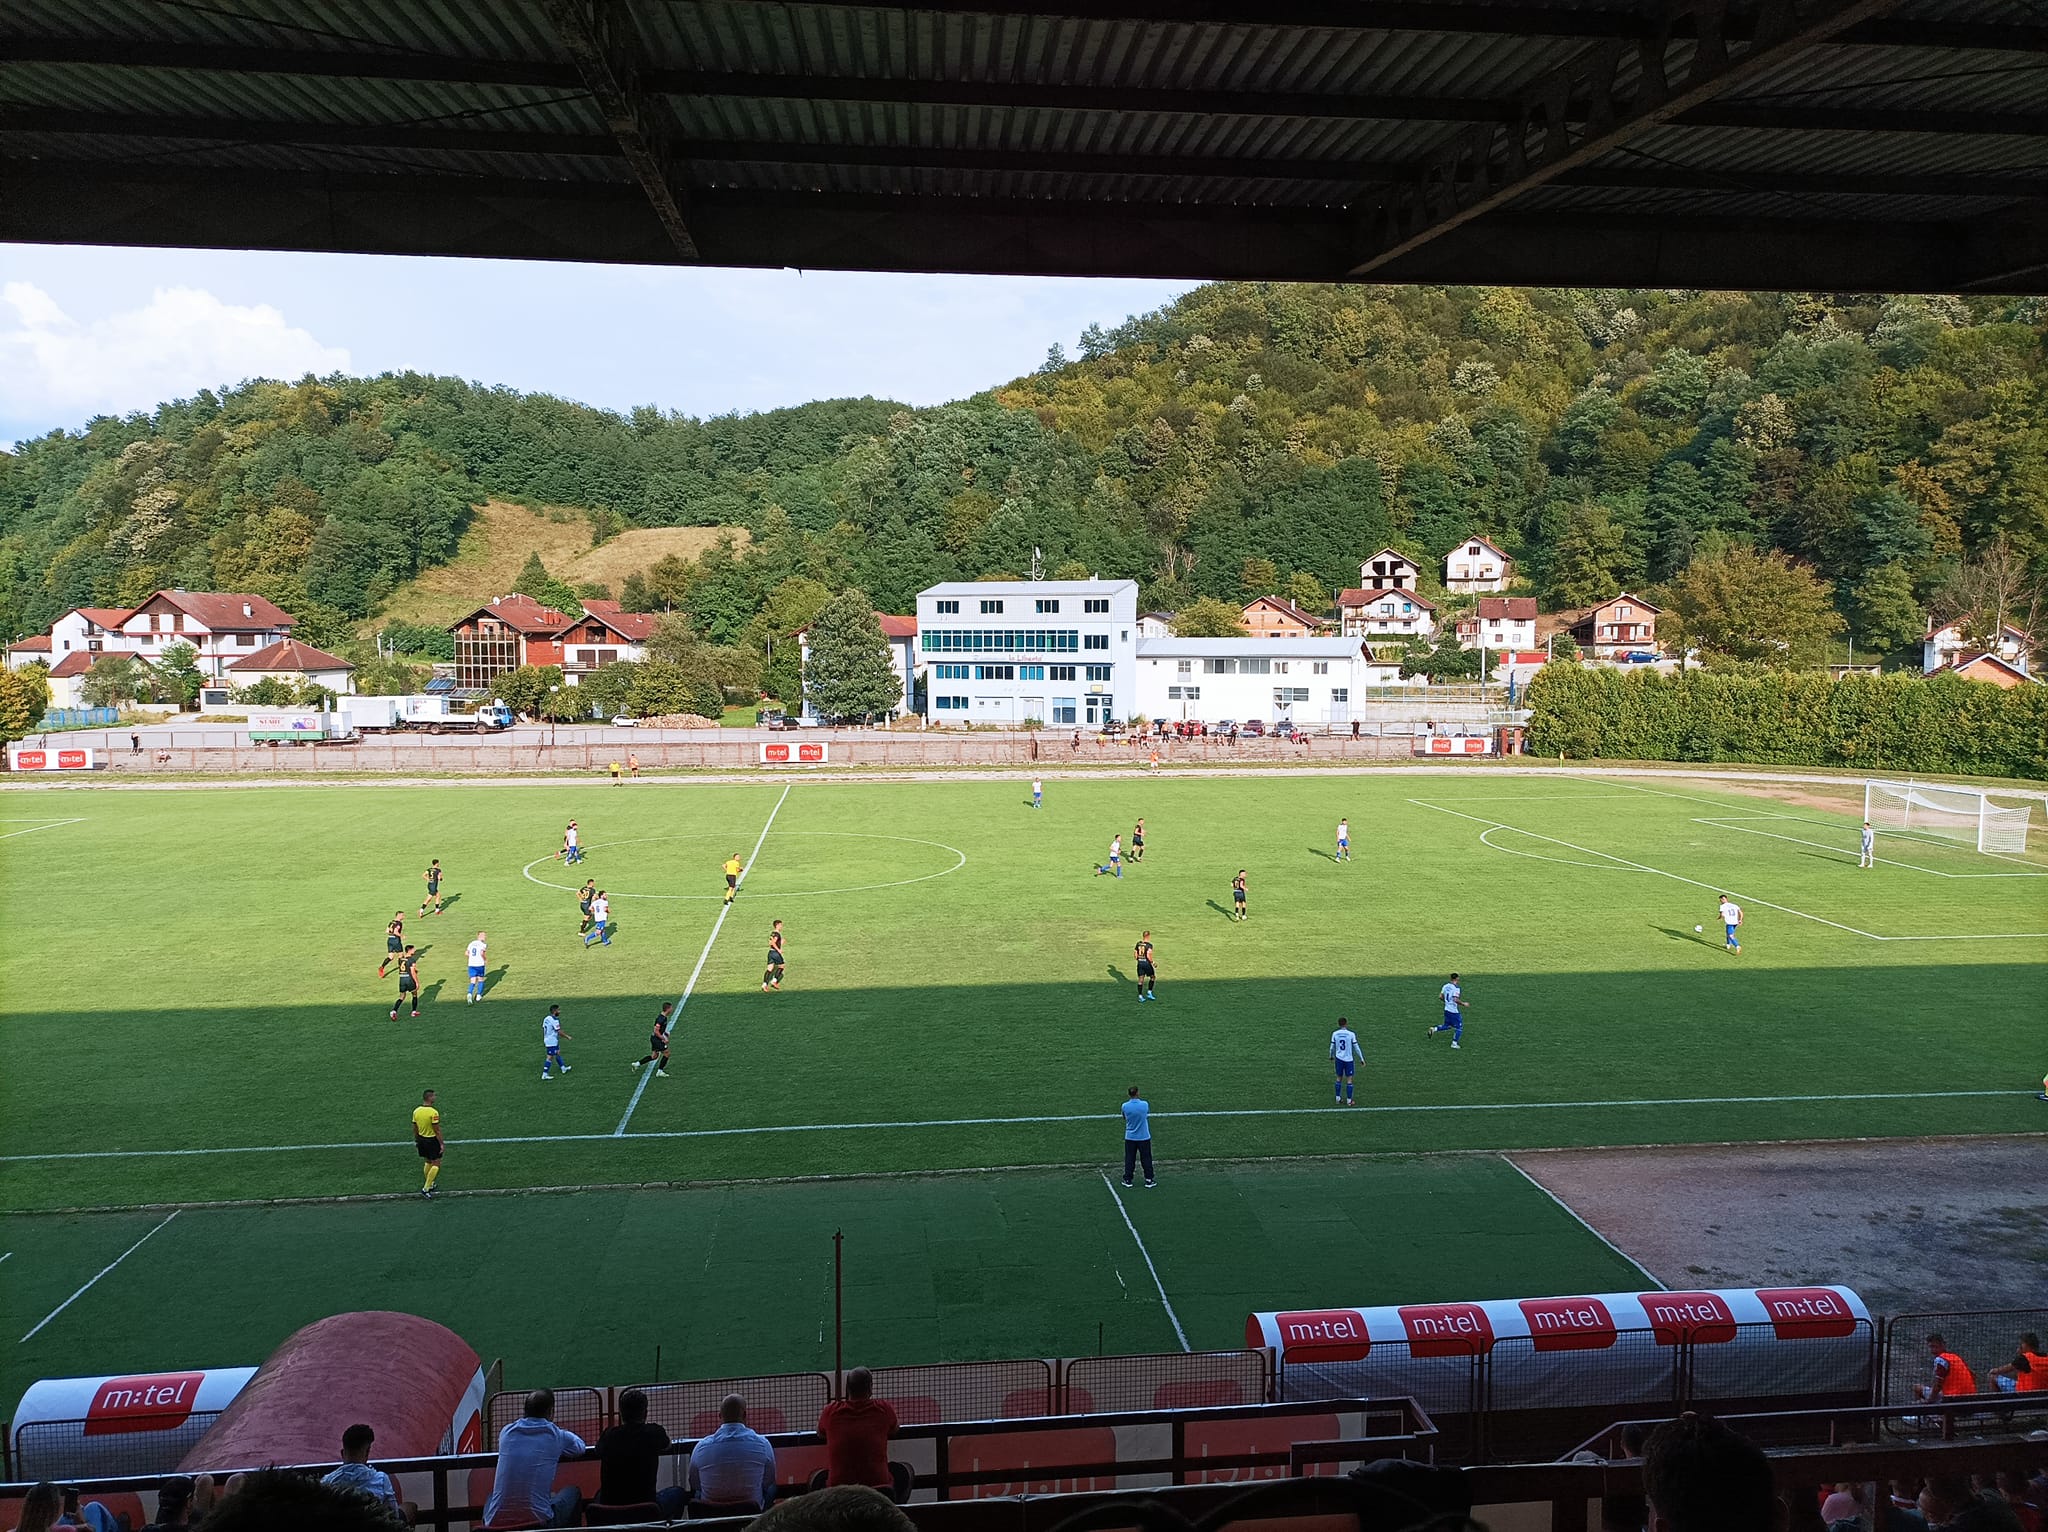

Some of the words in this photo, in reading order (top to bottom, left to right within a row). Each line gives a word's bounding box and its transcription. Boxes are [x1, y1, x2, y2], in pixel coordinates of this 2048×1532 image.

[1340, 1040, 1346, 1051] 3
[1534, 1305, 1603, 1329] m:tel
[1655, 1300, 1723, 1323] m:tel
[1773, 1295, 1841, 1317] m:tel
[1289, 1317, 1358, 1340] m:tel
[1413, 1311, 1481, 1335] m:tel
[102, 1381, 187, 1408] m:tel
